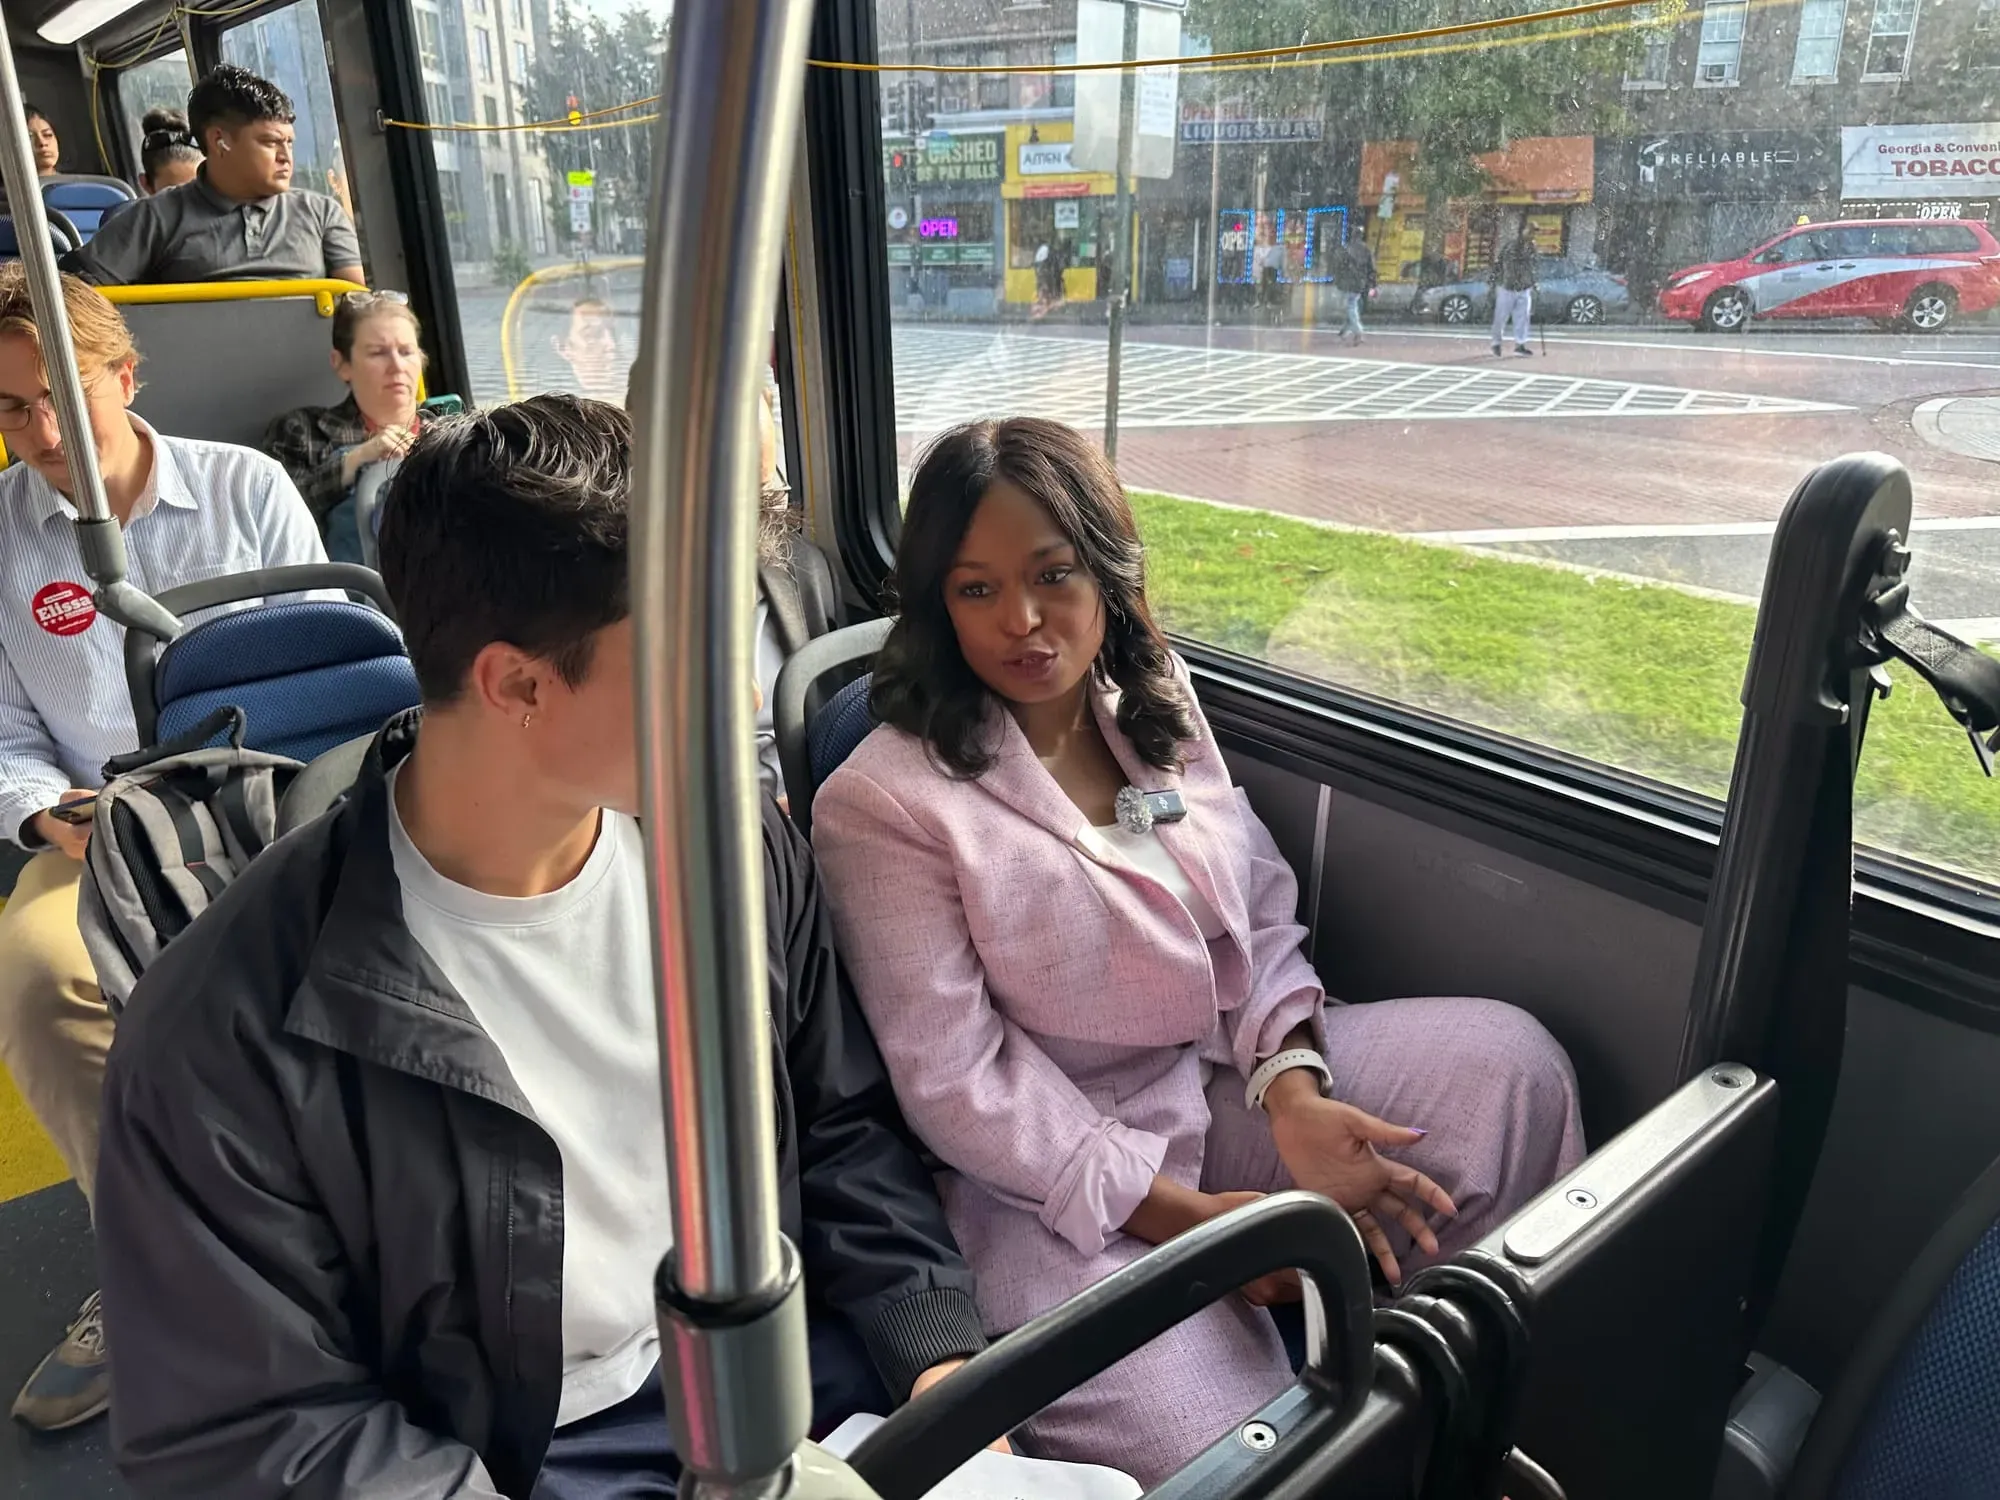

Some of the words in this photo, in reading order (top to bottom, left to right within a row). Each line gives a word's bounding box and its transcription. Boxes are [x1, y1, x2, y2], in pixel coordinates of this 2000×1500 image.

[1878, 143, 1931, 156] Georgia
[1934, 143, 1945, 153] &
[1671, 151, 1773, 165] RELIABLE
[1920, 204, 1961, 220] OPEN
[919, 218, 958, 237] OPEN
